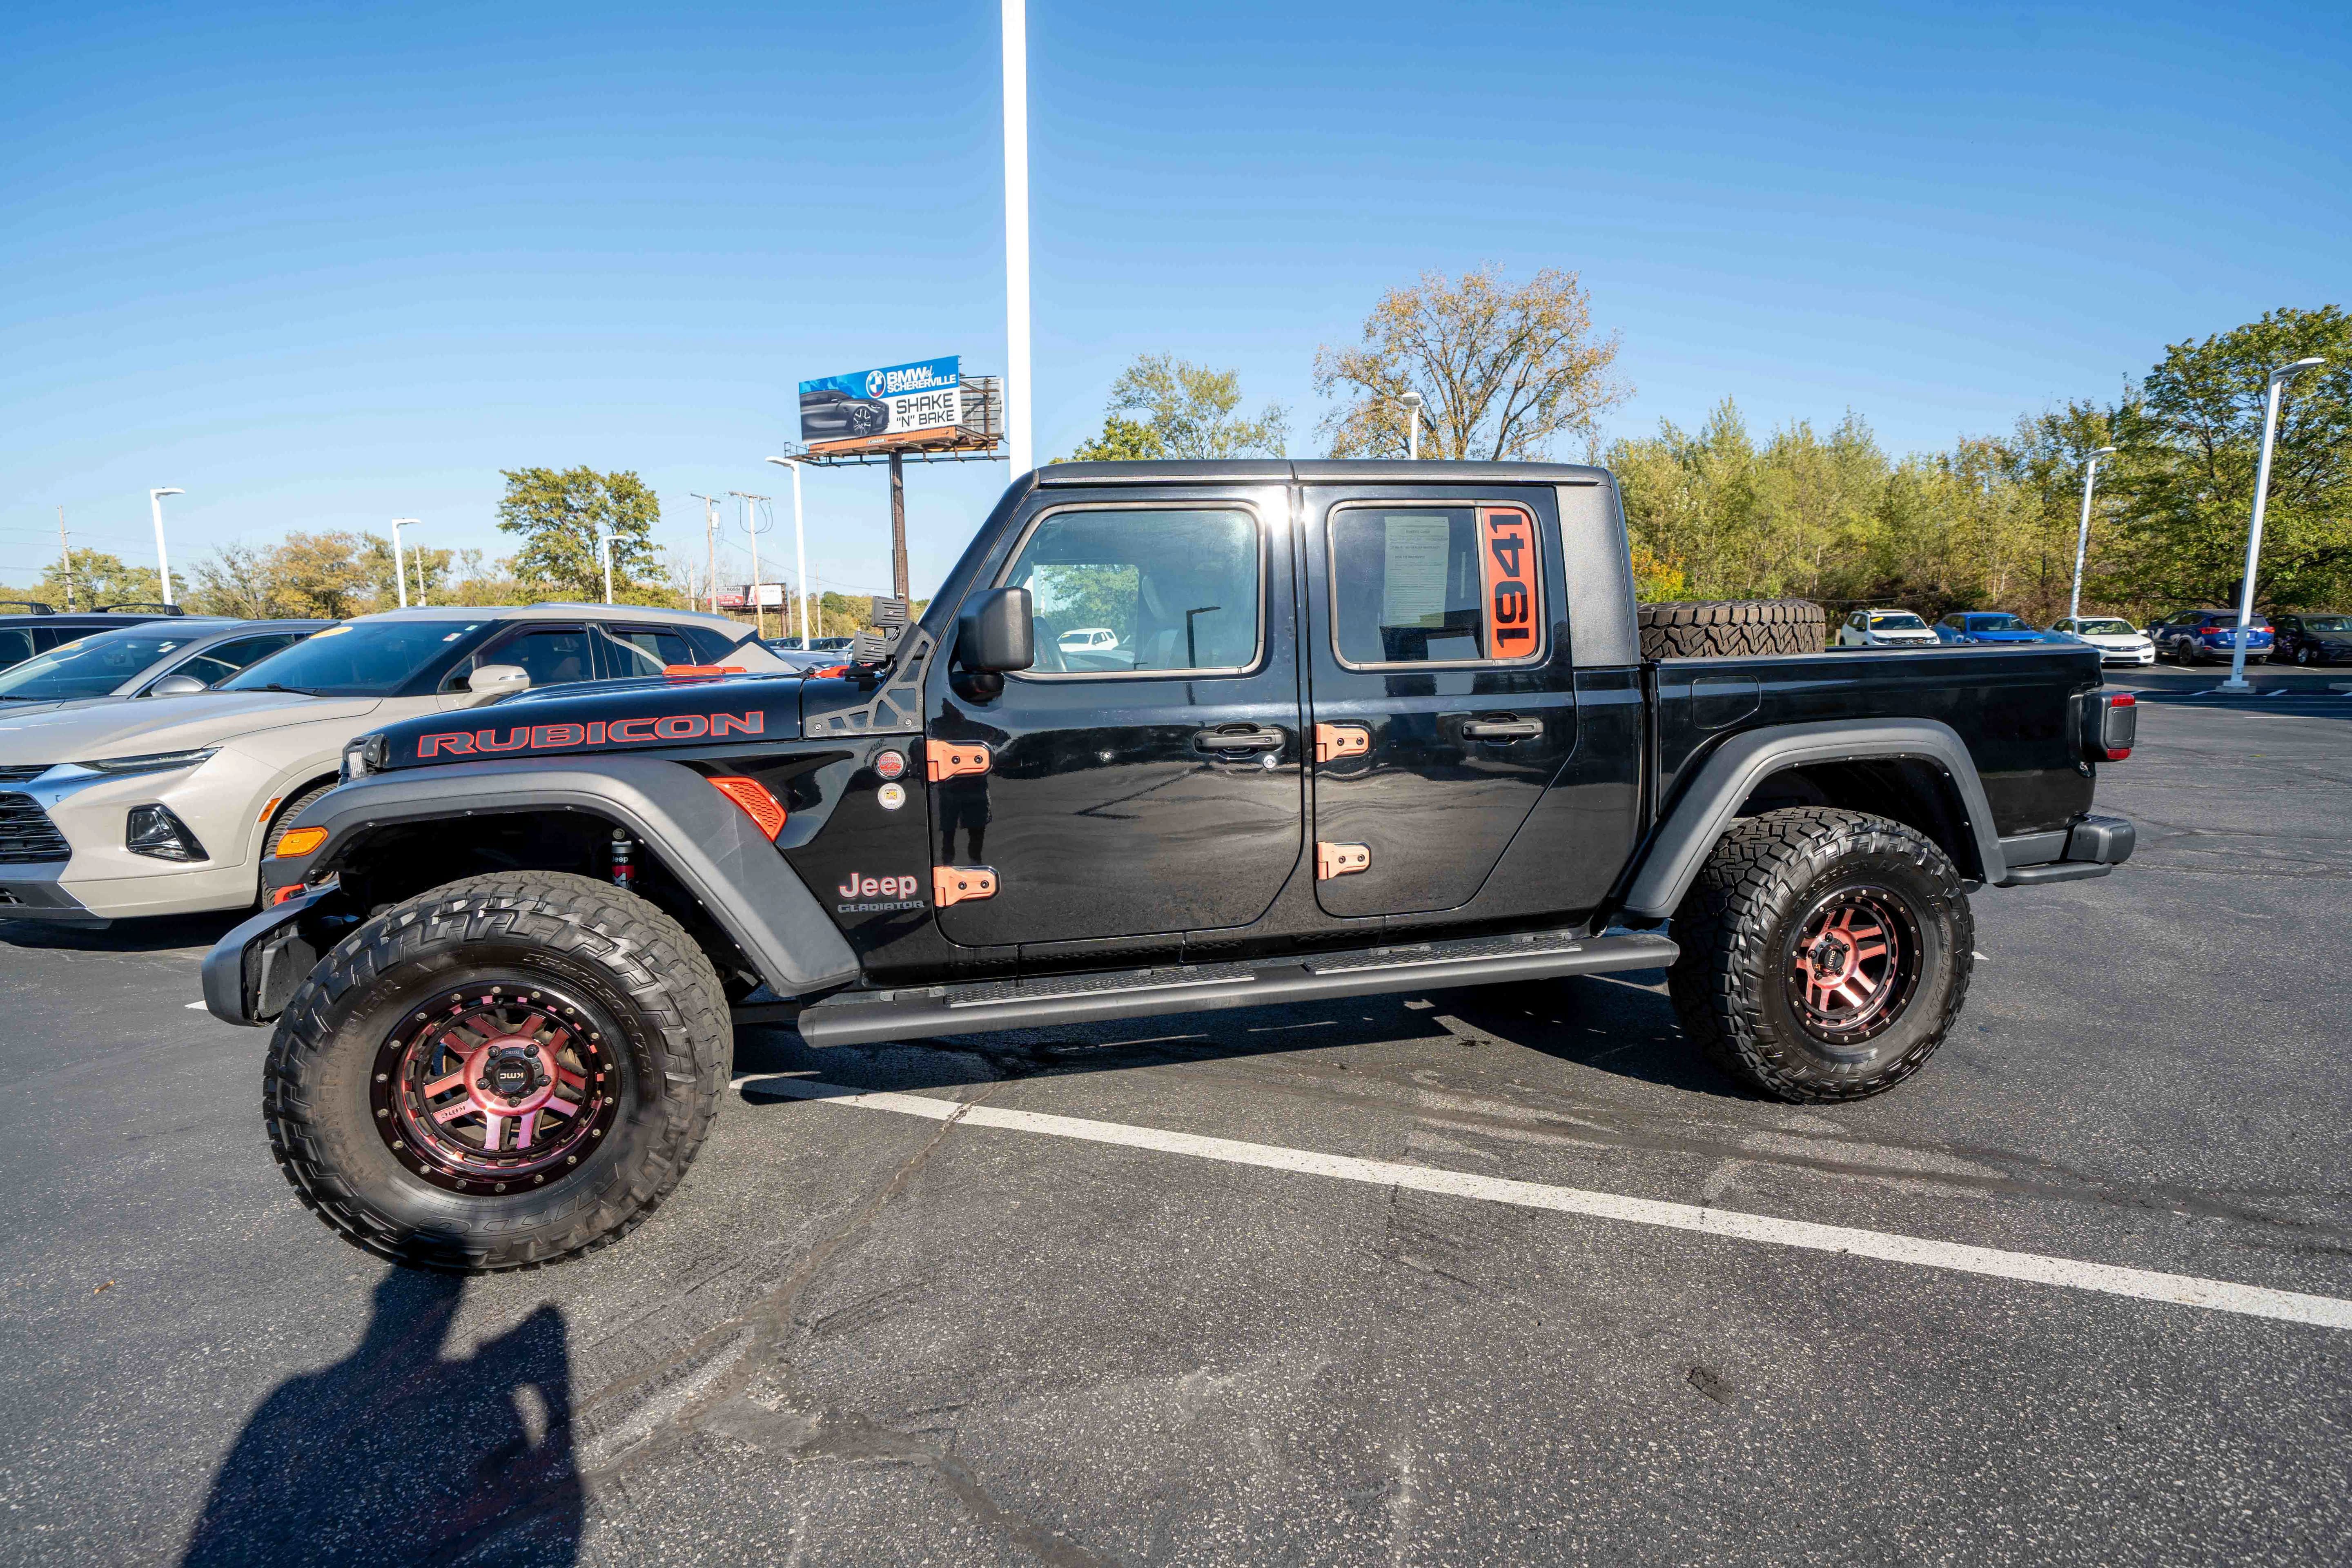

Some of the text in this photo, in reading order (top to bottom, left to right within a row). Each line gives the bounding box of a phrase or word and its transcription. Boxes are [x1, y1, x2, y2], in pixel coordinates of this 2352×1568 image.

[887, 365, 934, 385] BMW of
[887, 374, 956, 393] SCHERERVILLE
[896, 392, 953, 414] SHAKE
[919, 410, 954, 425] BAKE
[1489, 514, 1529, 648] 1941
[417, 711, 764, 757] RUBICON
[838, 873, 918, 899] Jeep
[837, 900, 925, 913] GLADIATOR
[1828, 951, 1836, 967] KMC
